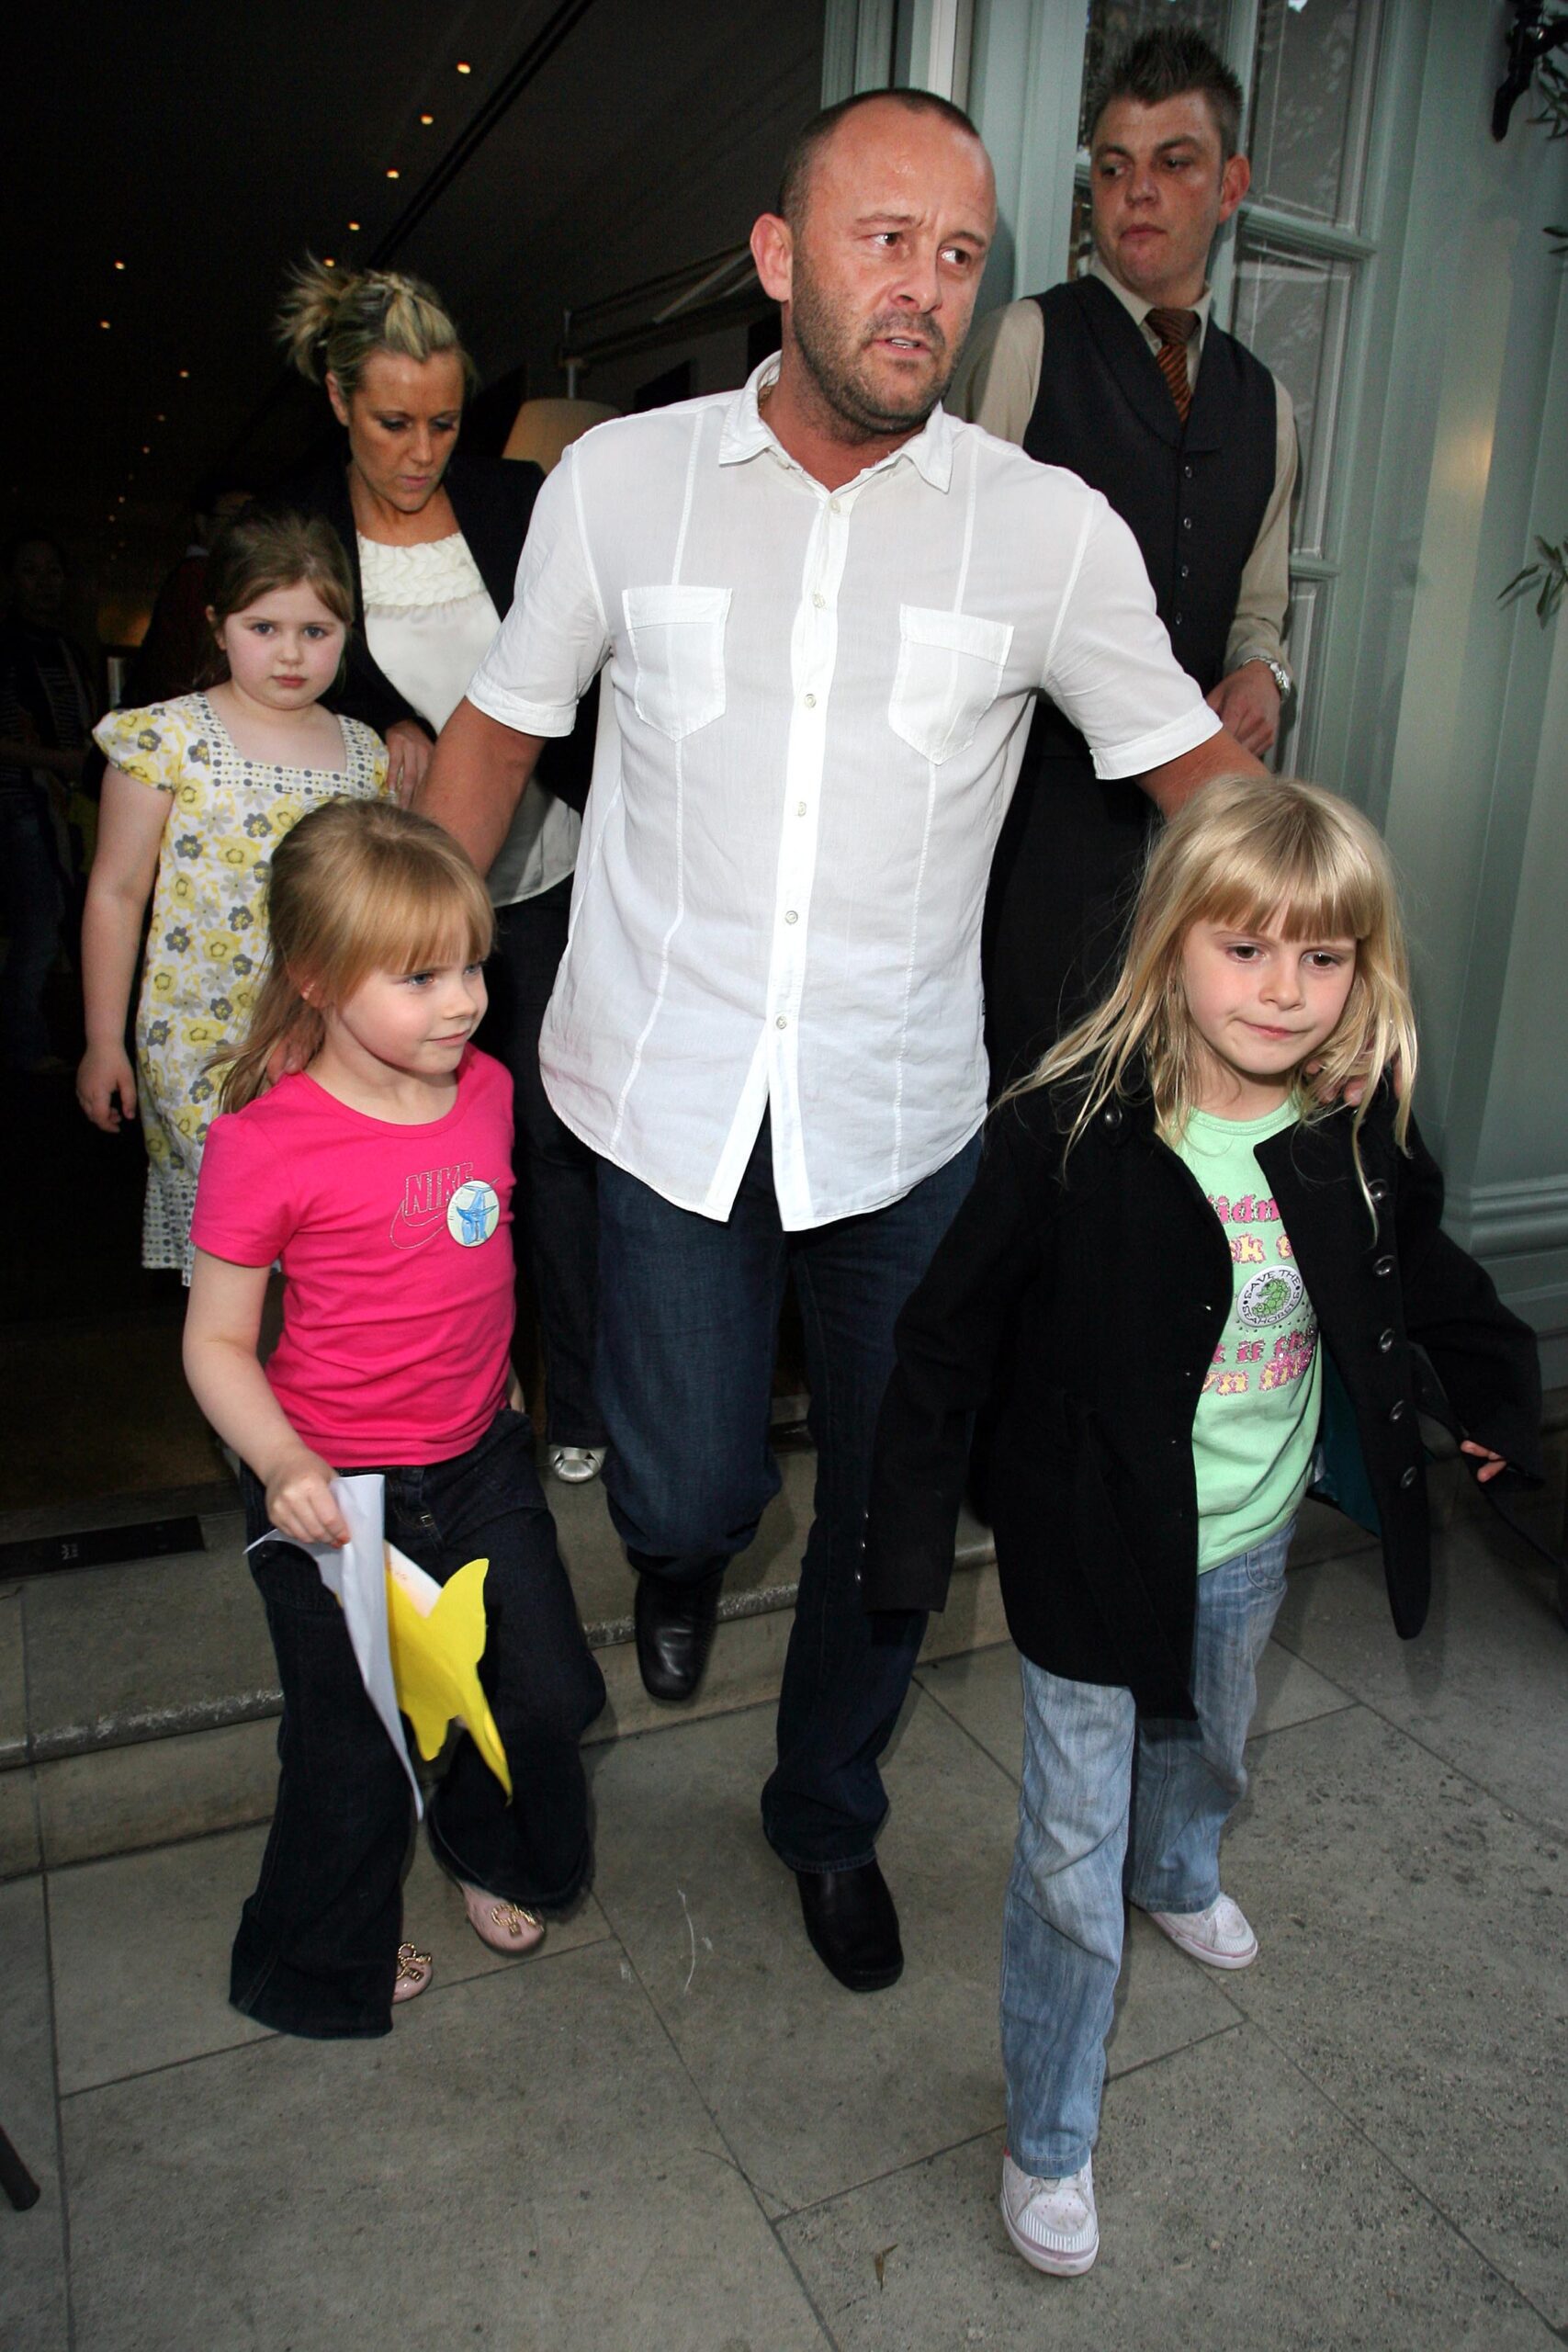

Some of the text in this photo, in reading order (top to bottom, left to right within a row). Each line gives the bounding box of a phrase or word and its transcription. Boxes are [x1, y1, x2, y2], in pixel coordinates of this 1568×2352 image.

[405, 1162, 475, 1216] NIKE
[1244, 1270, 1301, 1299] SAVE THE
[1242, 1292, 1300, 1325] SEAHORSES
[1235, 1339, 1265, 1364] if
